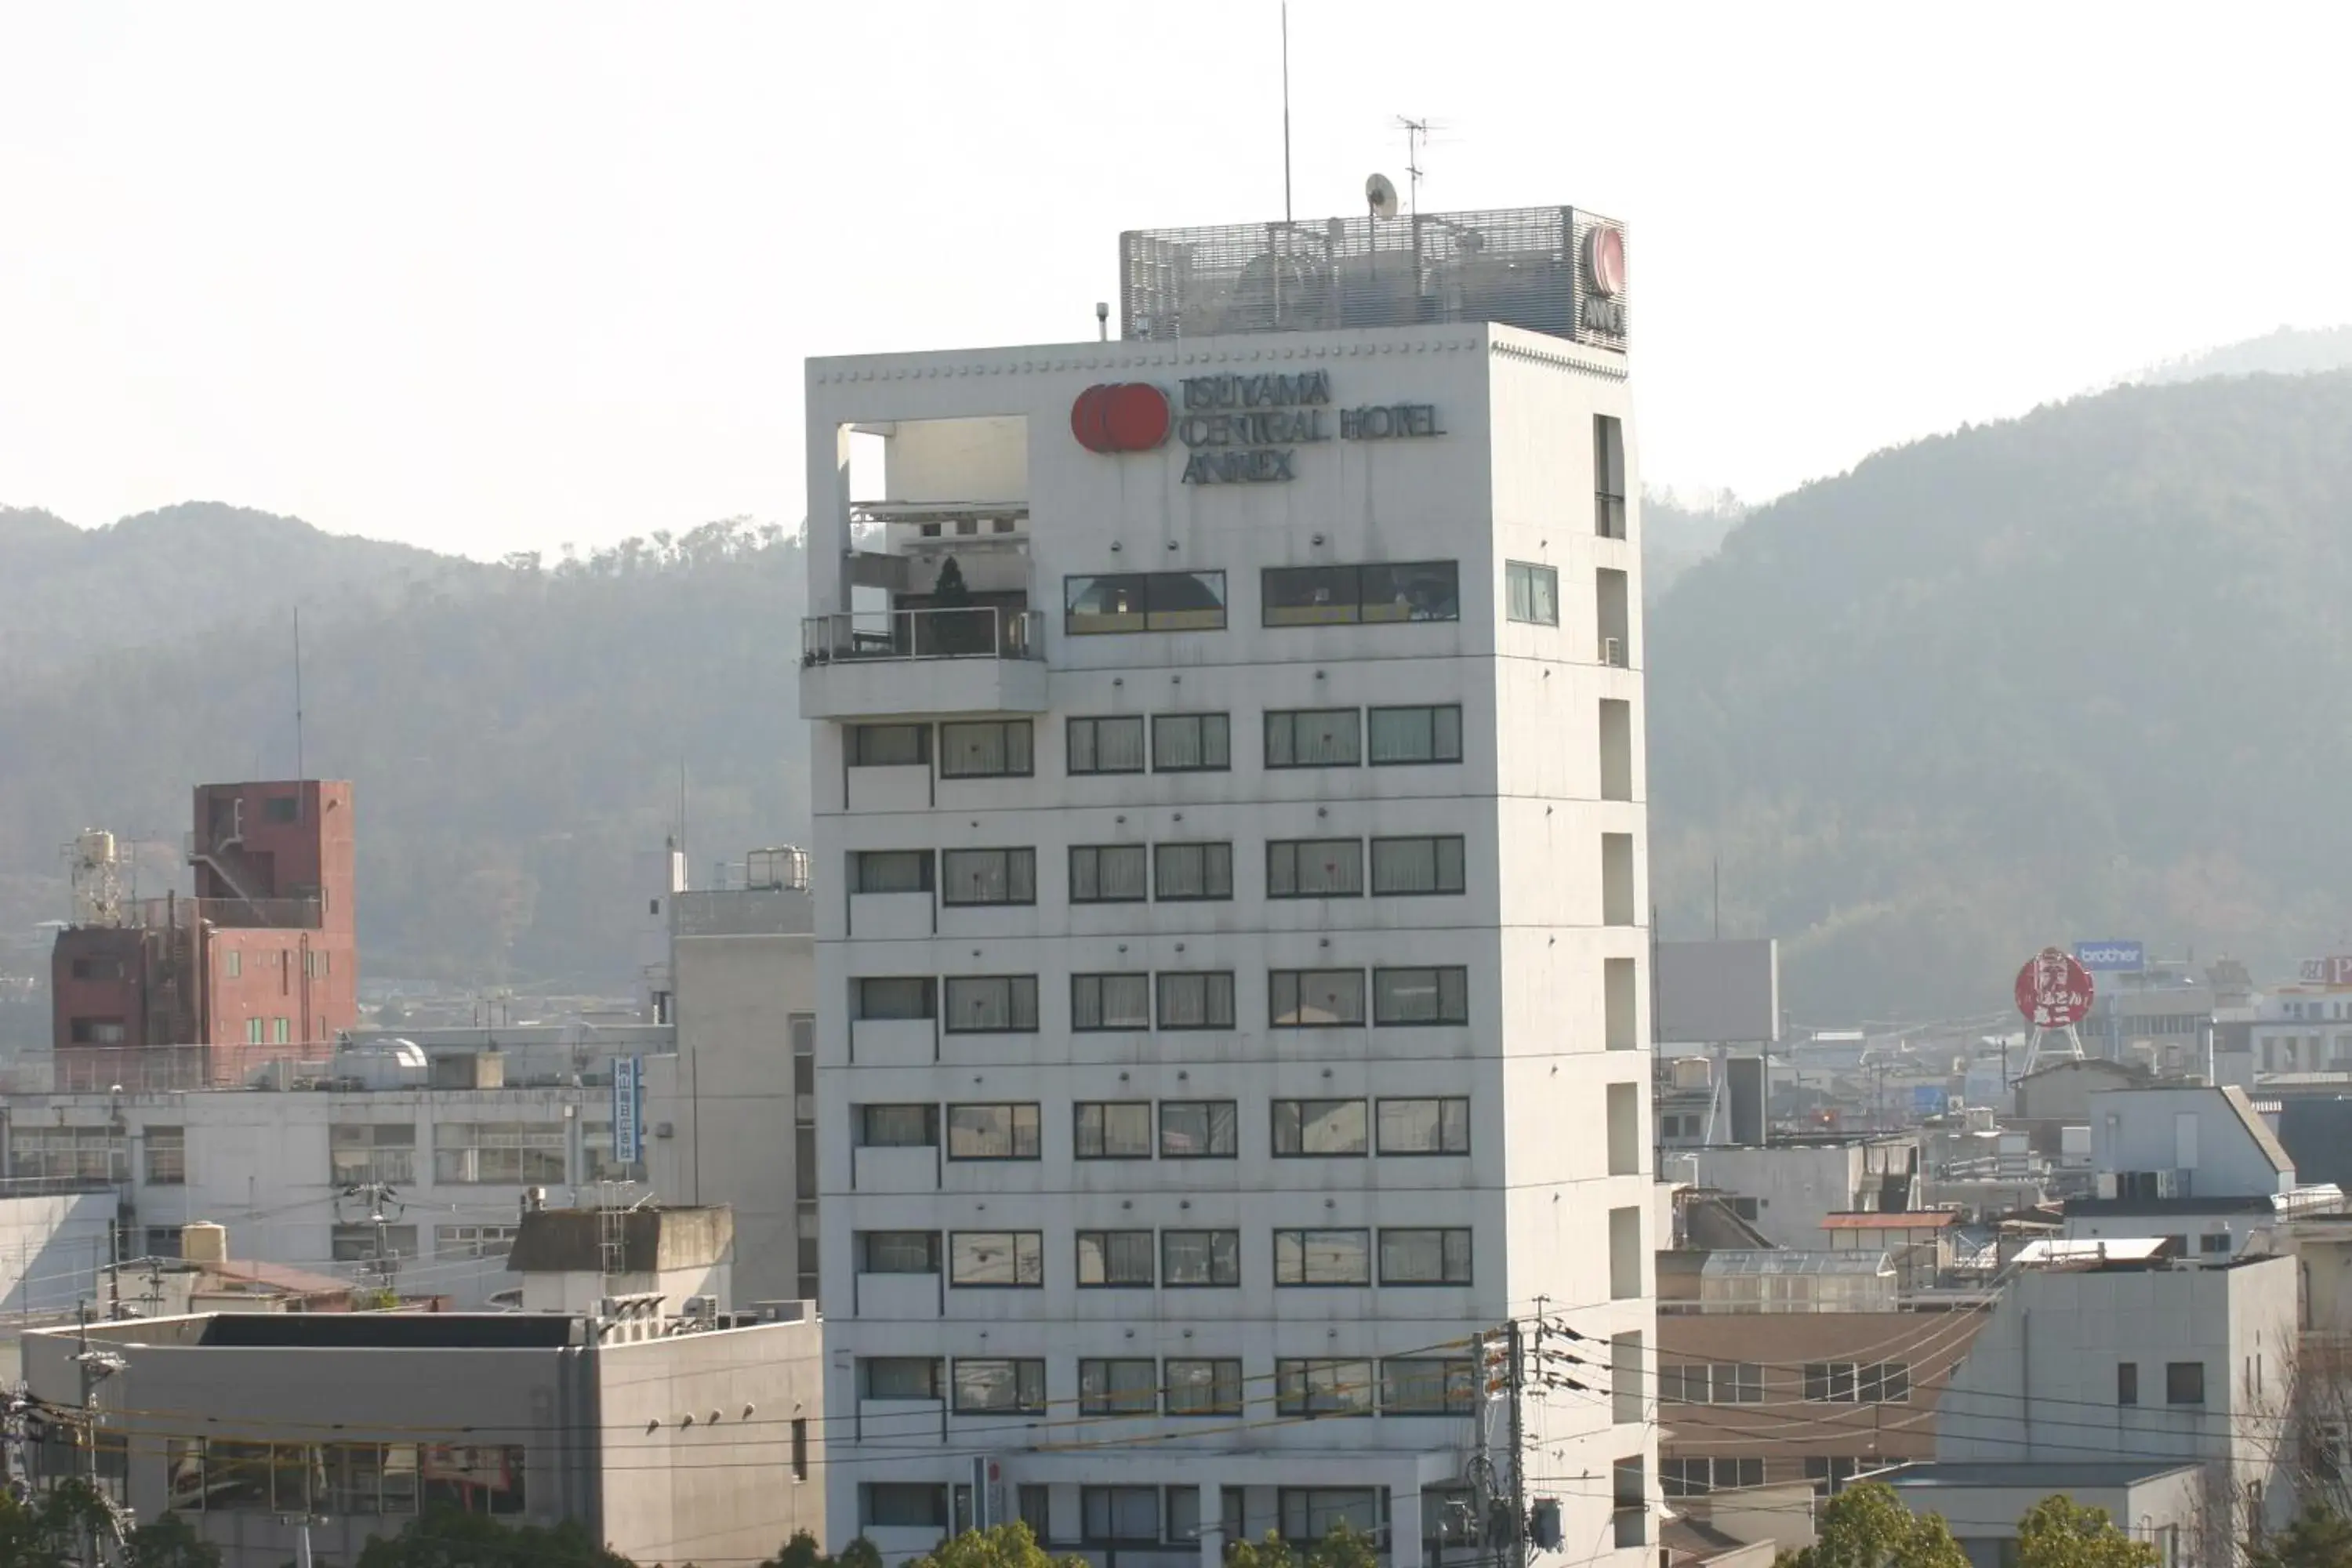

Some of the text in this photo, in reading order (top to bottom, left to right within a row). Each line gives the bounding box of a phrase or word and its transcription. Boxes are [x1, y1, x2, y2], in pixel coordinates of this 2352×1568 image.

[1179, 369, 1330, 409] TSUYAMA
[1179, 405, 1448, 448] CENTRAL HOTEL
[1181, 449, 1298, 485] ANNEX
[2082, 948, 2140, 962] brother
